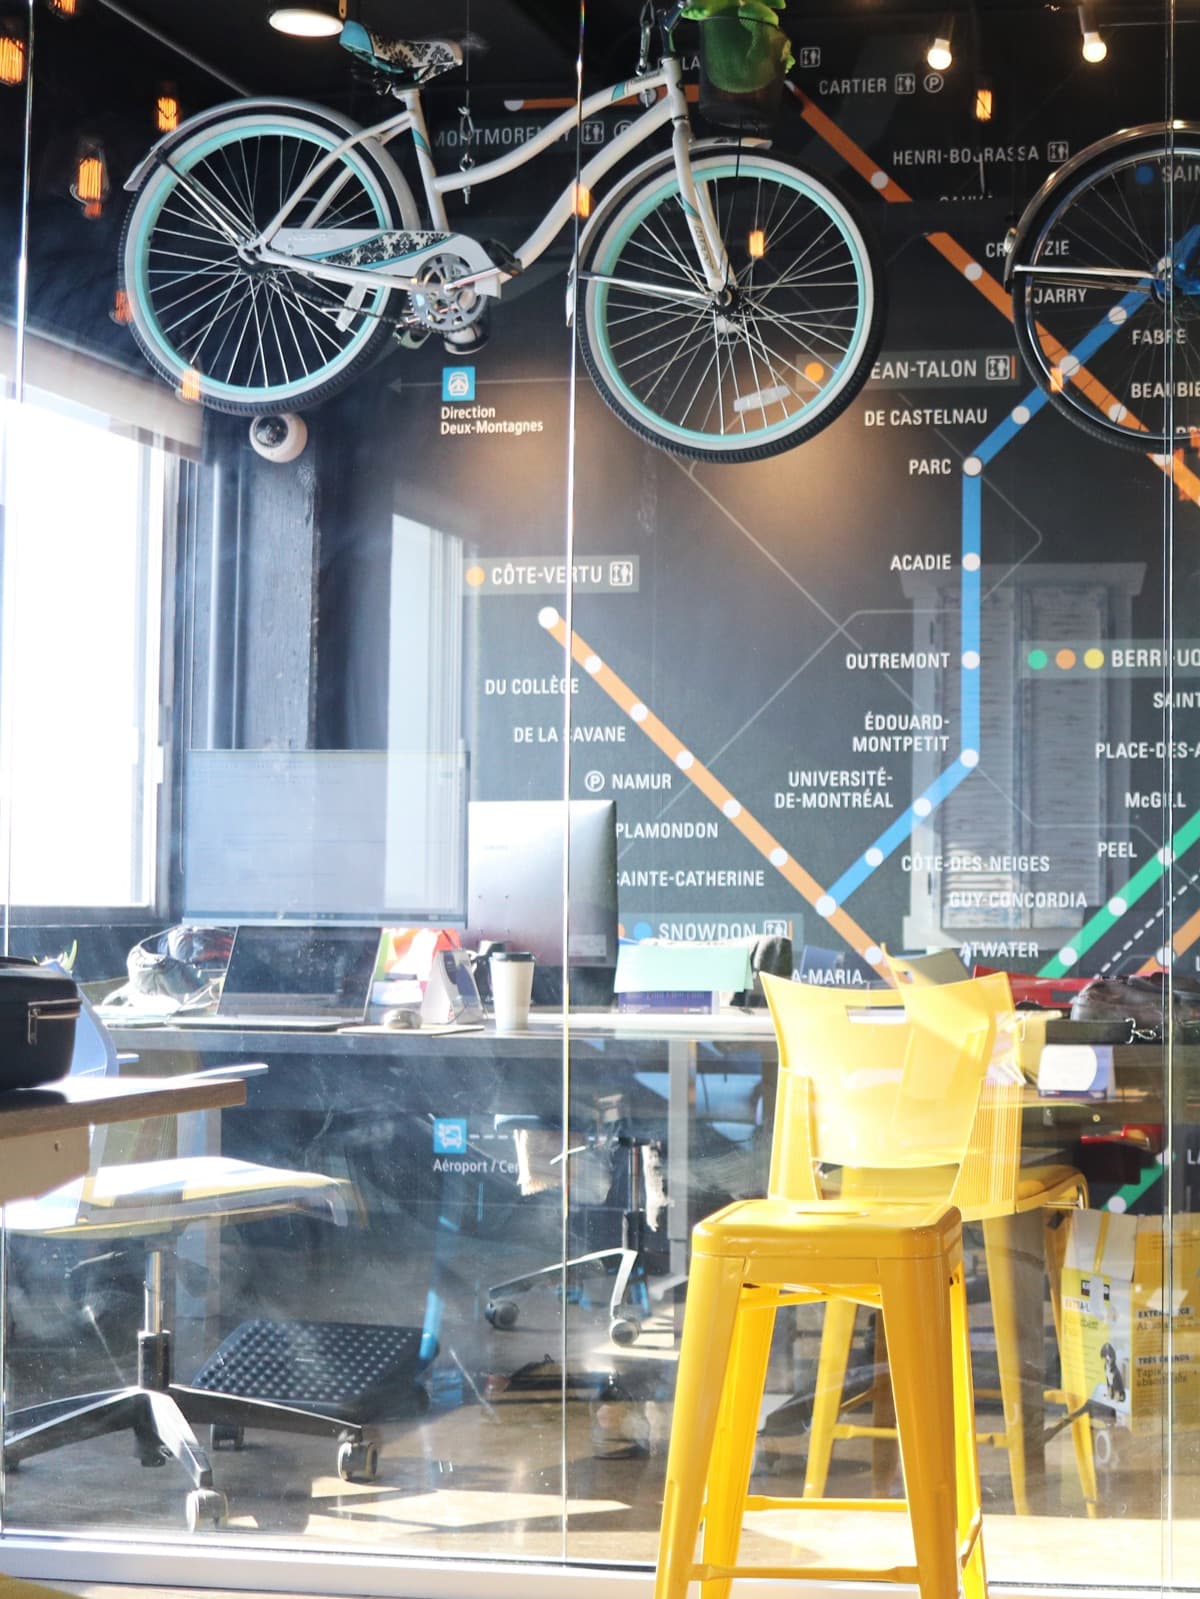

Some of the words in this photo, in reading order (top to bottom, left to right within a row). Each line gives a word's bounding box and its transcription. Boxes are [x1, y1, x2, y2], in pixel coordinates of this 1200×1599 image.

[819, 78, 887, 95] CARTIER
[985, 240, 1070, 258] CRZIE
[1034, 287, 1087, 304] JARRY
[870, 360, 977, 380] EAN-TALON
[441, 406, 496, 420] Direction
[864, 410, 885, 427] DE
[890, 408, 988, 426] CASTELNAU
[441, 419, 544, 436] Deux-Montagnes
[909, 459, 952, 476] PARC
[890, 554, 952, 571] ACADIE
[846, 652, 951, 670] OUTREMONT
[485, 679, 507, 695] DU
[864, 711, 950, 731] ÉDOUARD-
[514, 727, 534, 743] DE
[538, 727, 559, 743] LA
[852, 735, 950, 753] MONTPETIT
[612, 773, 672, 790] NAMUR
[788, 766, 893, 787] UNIVERSITÉ-
[774, 788, 894, 809] DE-MONTRÉAL
[616, 822, 719, 839] PLAMONDON
[1097, 841, 1138, 859] PEEL
[901, 850, 1050, 872] CÔTE-DES-NEIGES
[615, 870, 765, 888] AINTE-CATHERINE
[950, 892, 1088, 909] GUY-CONCORDIA
[658, 923, 756, 941] SNOWDON
[960, 941, 1039, 958] ATWATER
[433, 1157, 487, 1177] Aéroport
